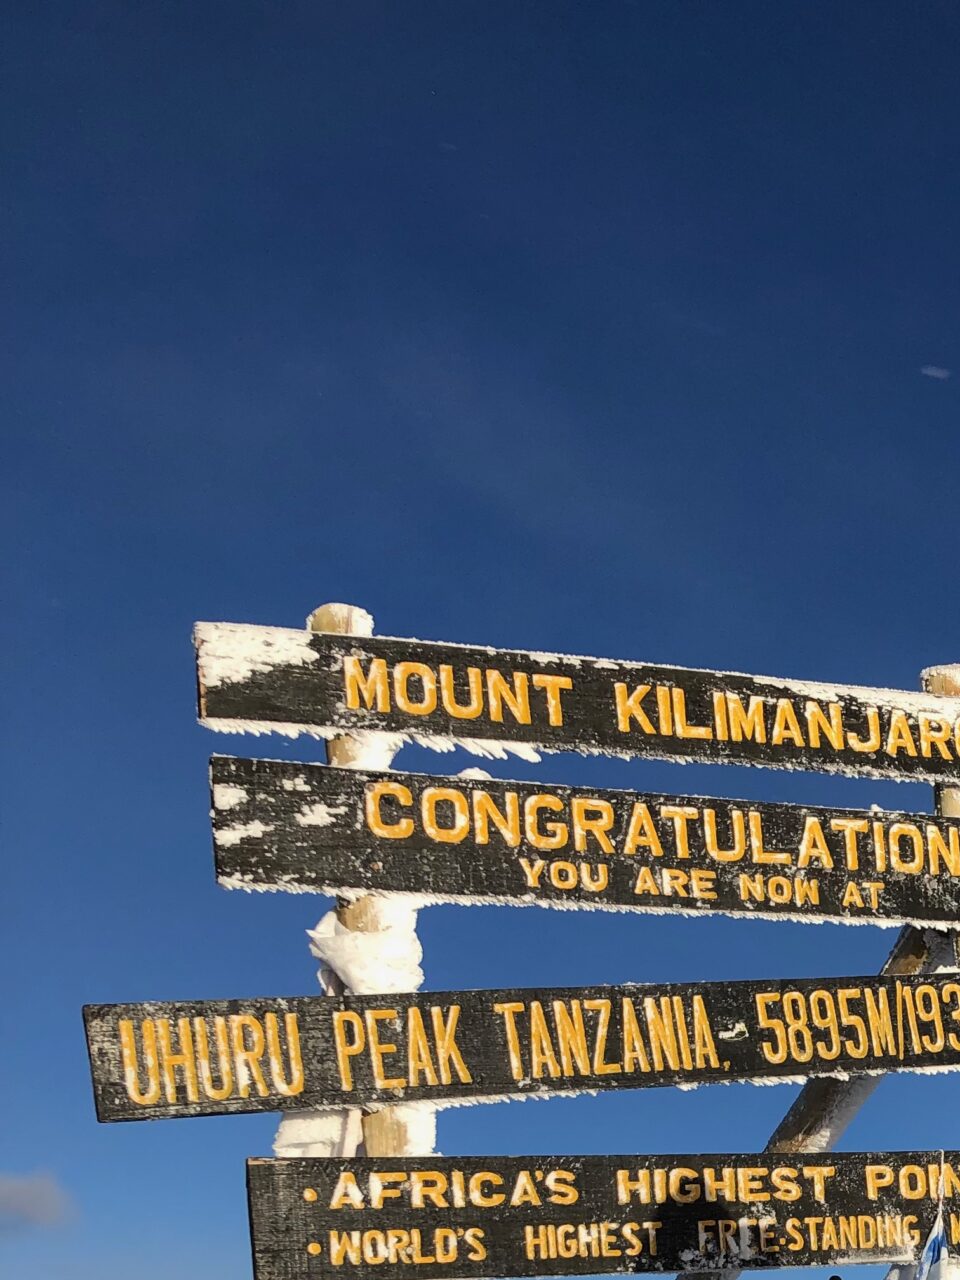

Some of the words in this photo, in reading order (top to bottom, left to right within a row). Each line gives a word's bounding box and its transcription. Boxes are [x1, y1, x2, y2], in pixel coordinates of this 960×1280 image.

[343, 655, 572, 727] MOUNT
[518, 857, 609, 892] YOU
[634, 866, 717, 900] ARE
[740, 873, 820, 906] NOW
[842, 880, 885, 910] AT
[119, 1012, 304, 1105] UHURU
[333, 1005, 473, 1091] PEAK
[329, 1170, 580, 1209] AFRICA'S
[617, 1165, 835, 1204] HIGHEST
[329, 1228, 488, 1266] WORLD'S
[525, 1221, 662, 1260] HIGHEST
